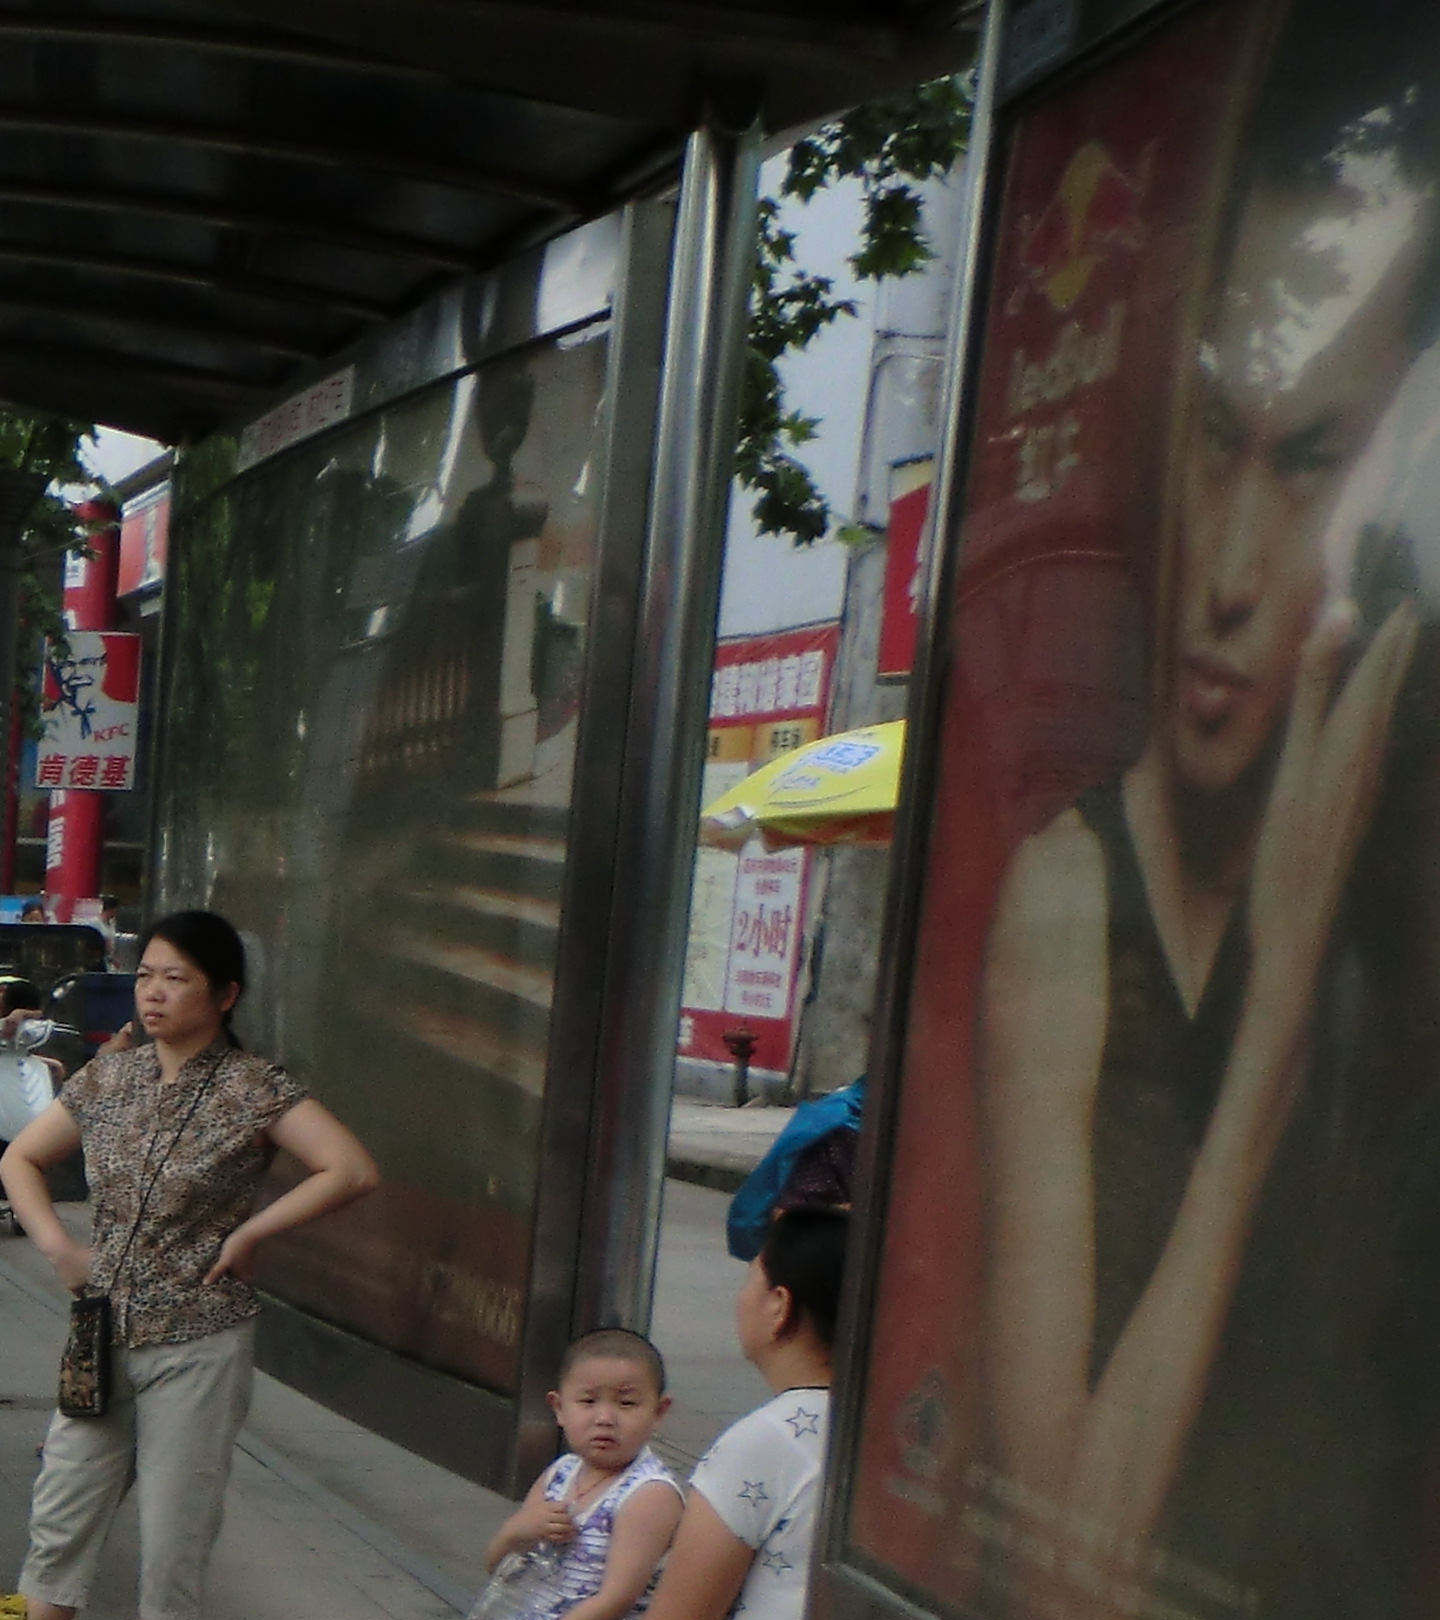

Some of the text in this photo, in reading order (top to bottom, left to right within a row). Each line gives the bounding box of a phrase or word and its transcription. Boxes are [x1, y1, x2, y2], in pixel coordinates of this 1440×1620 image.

[93, 722, 129, 742] KFC
[38, 753, 132, 787] 肯德基
[735, 903, 792, 959] 2小时
